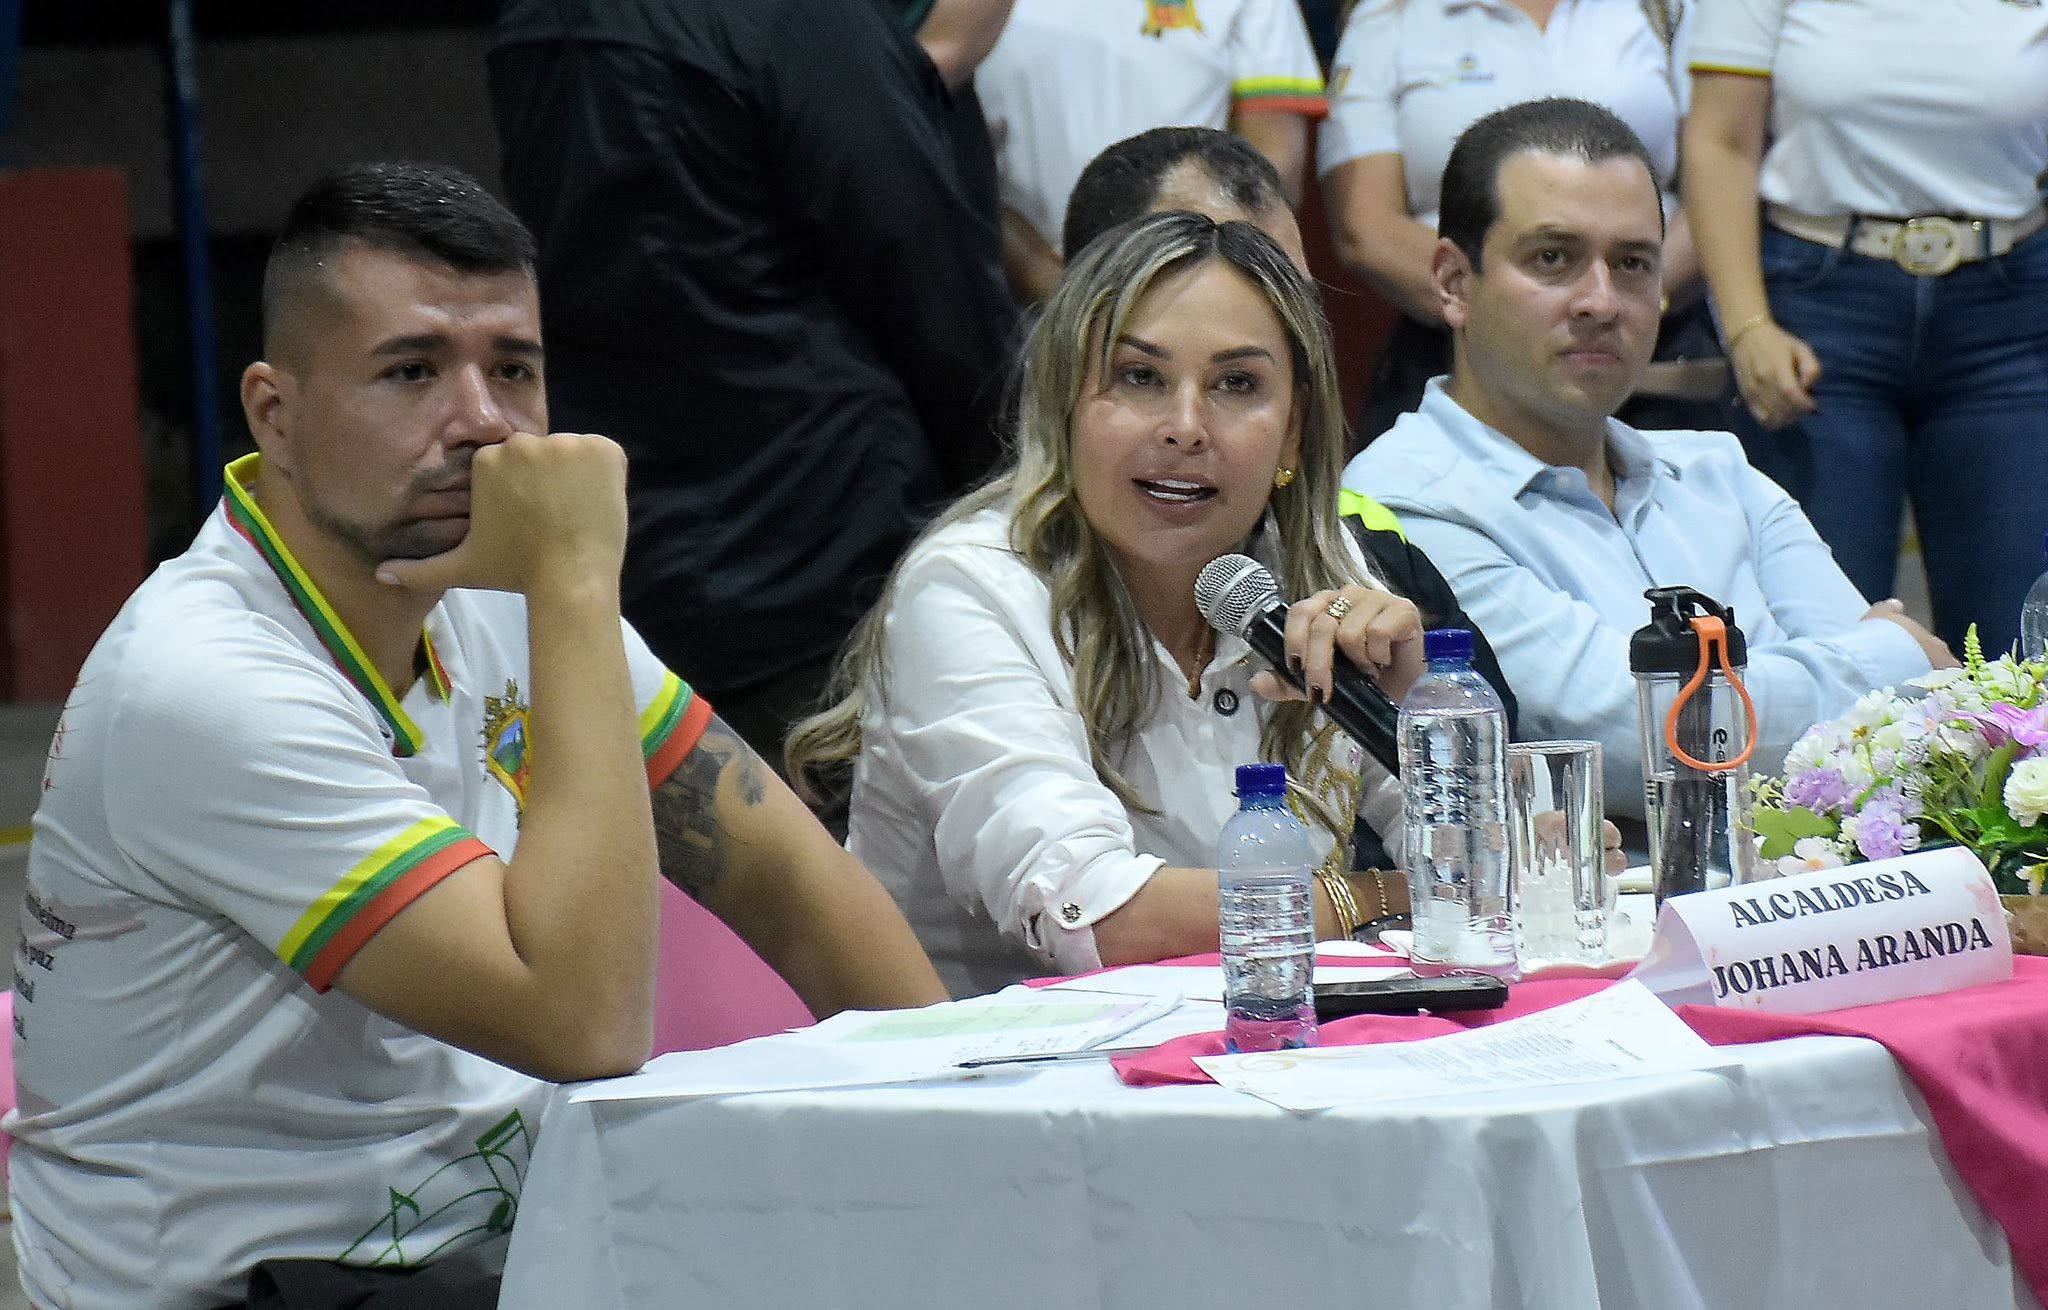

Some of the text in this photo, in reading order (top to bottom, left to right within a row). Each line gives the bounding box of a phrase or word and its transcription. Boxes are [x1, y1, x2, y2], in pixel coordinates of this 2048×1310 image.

[1728, 870, 1931, 928] ALCALDESA
[1712, 918, 1993, 999] JOHANA ARANDA
